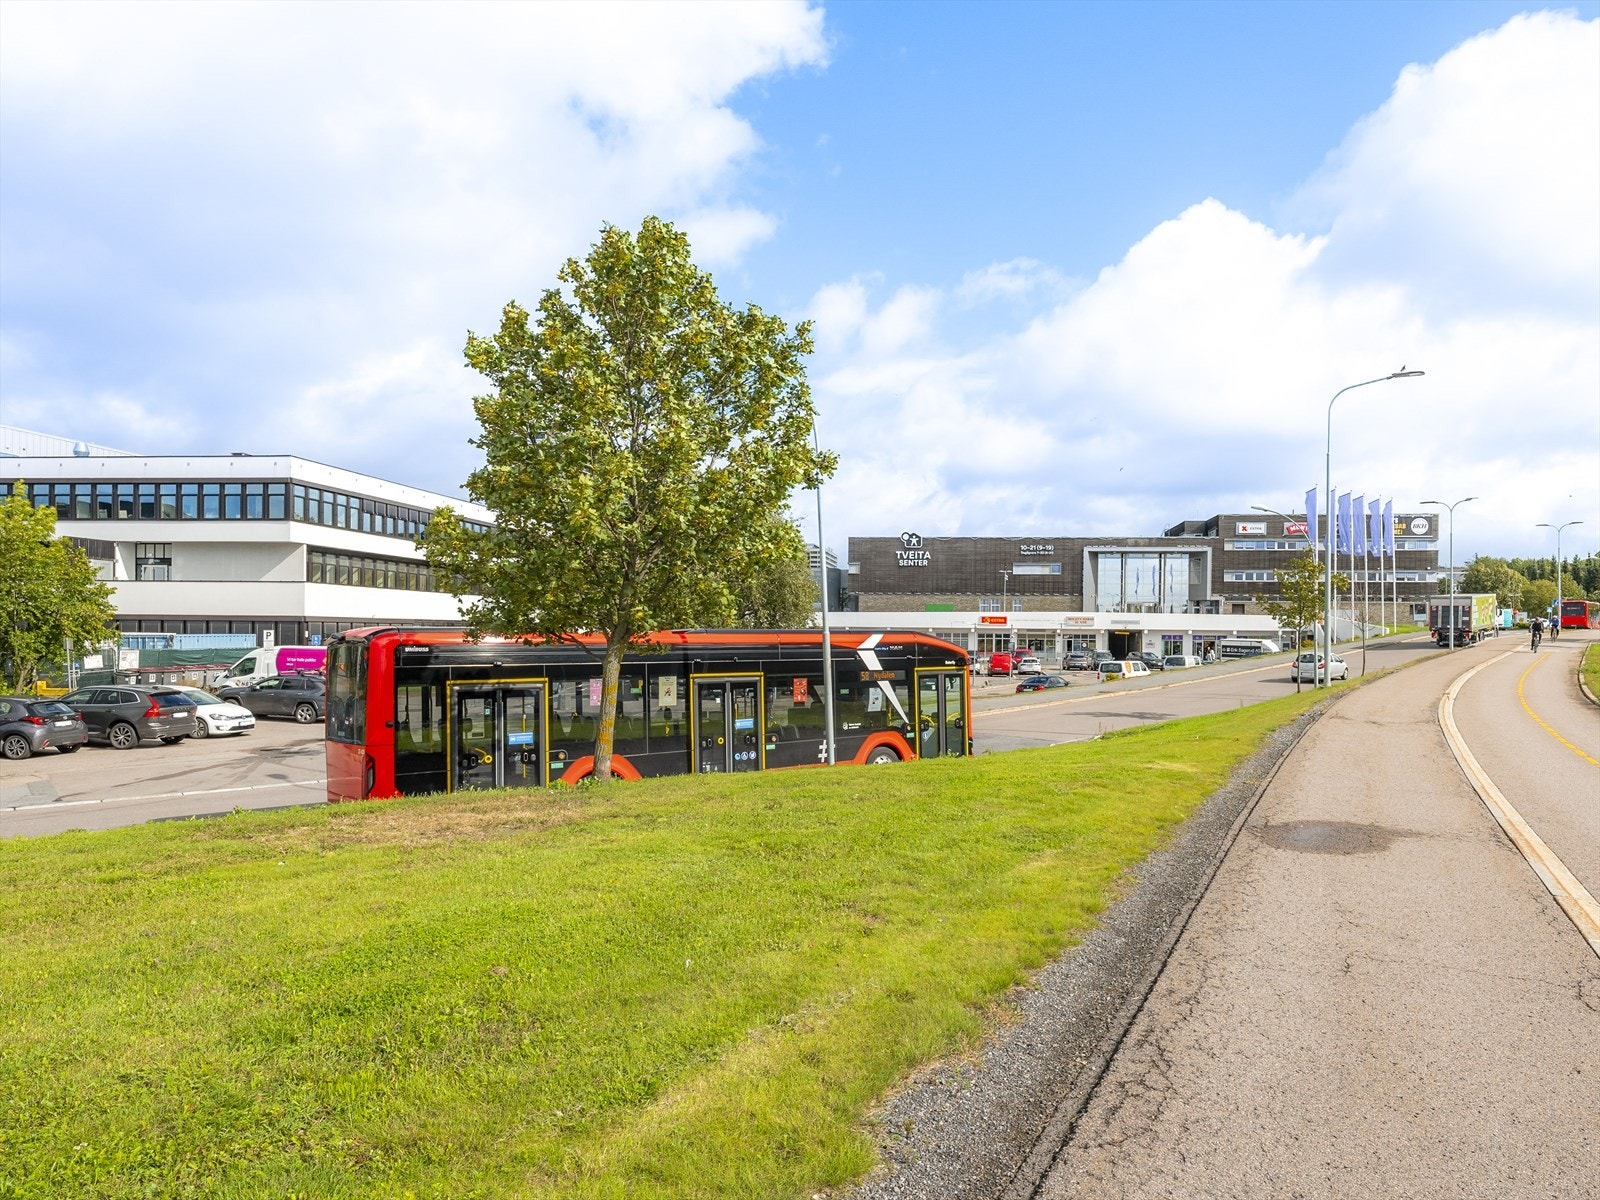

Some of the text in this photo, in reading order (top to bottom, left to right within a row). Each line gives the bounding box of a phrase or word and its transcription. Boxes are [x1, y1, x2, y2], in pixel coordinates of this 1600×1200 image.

[895, 550, 932, 560] TVEITA
[898, 559, 929, 567] SENTER
[265, 631, 272, 640] P
[860, 671, 895, 681] 58 Nydalen
